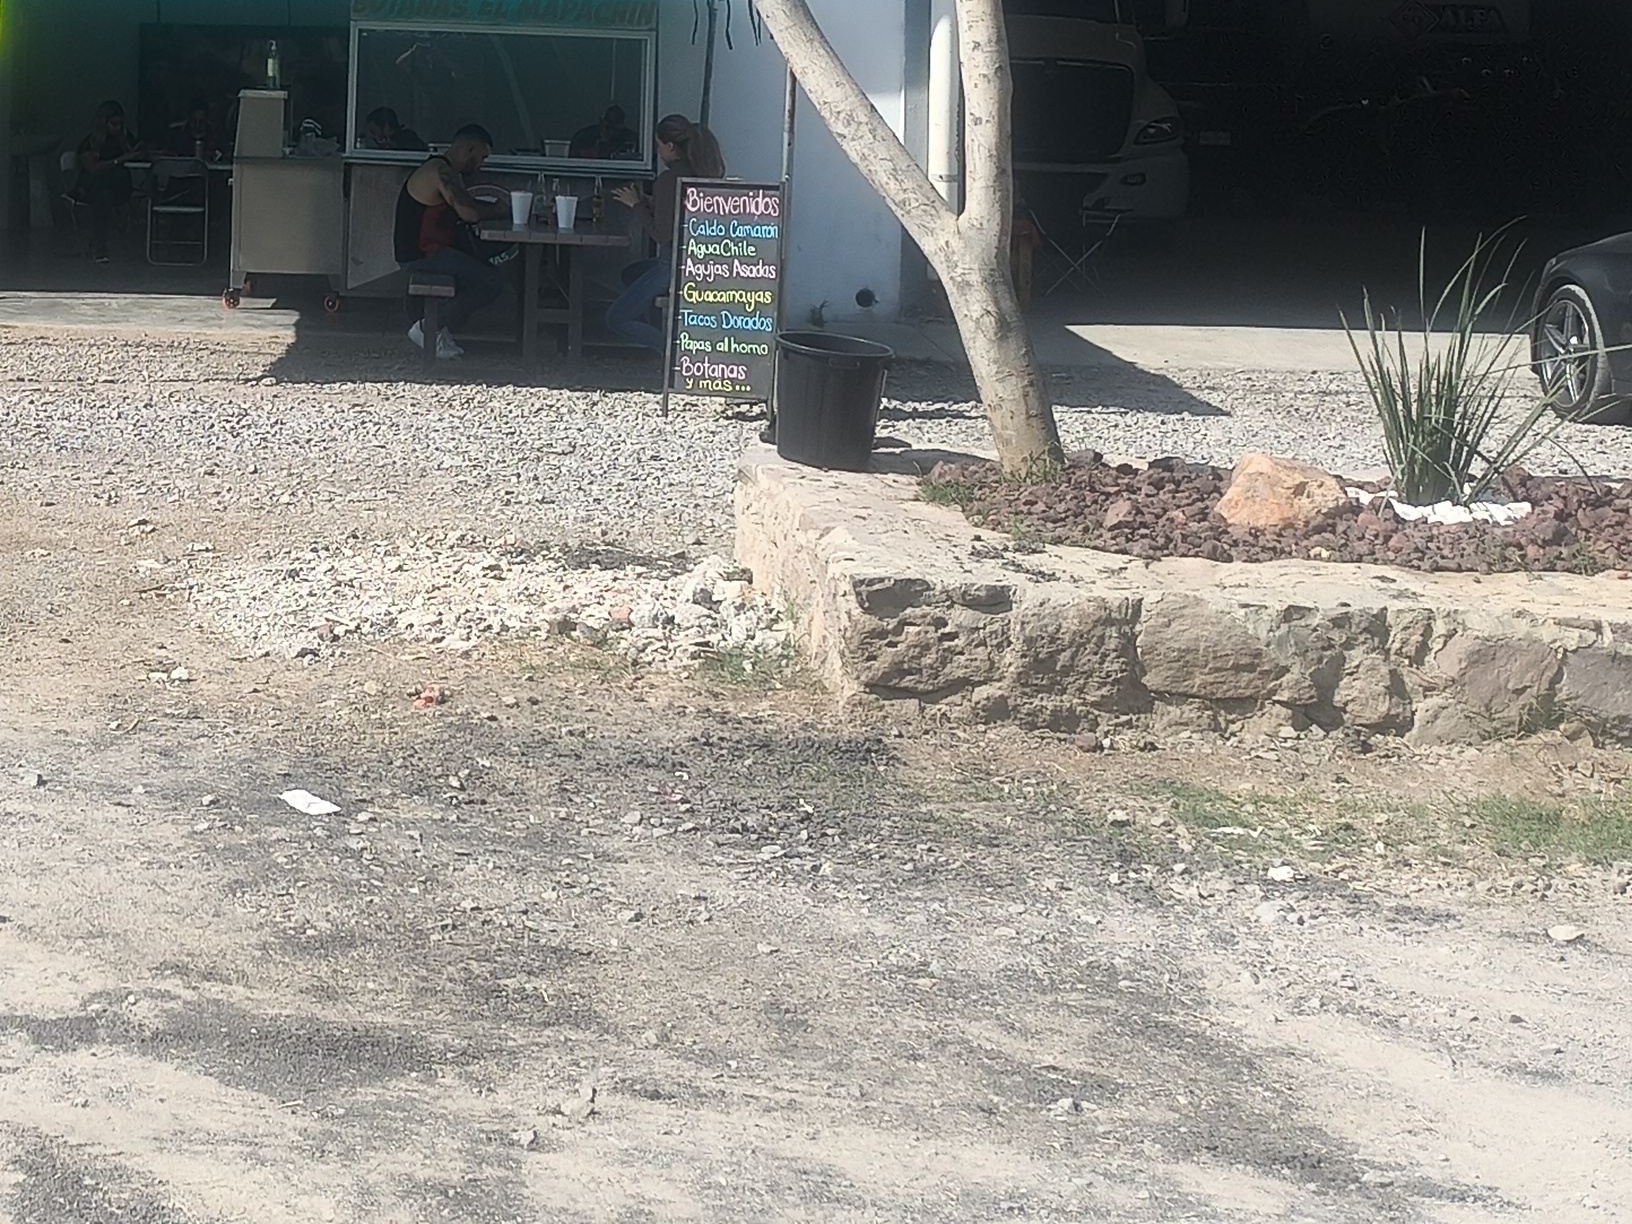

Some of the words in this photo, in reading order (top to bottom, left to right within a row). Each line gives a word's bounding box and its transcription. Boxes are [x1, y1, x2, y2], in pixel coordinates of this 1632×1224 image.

[686, 188, 779, 216] Bienvenidos
[689, 218, 725, 236] Caldo
[686, 258, 729, 282] Agujas
[733, 259, 776, 279] Asadas
[683, 282, 772, 312] Guacamayas
[680, 309, 717, 328] Tacos
[721, 311, 773, 331] Dorados
[680, 332, 712, 355] Papas
[680, 356, 747, 379] Botanas
